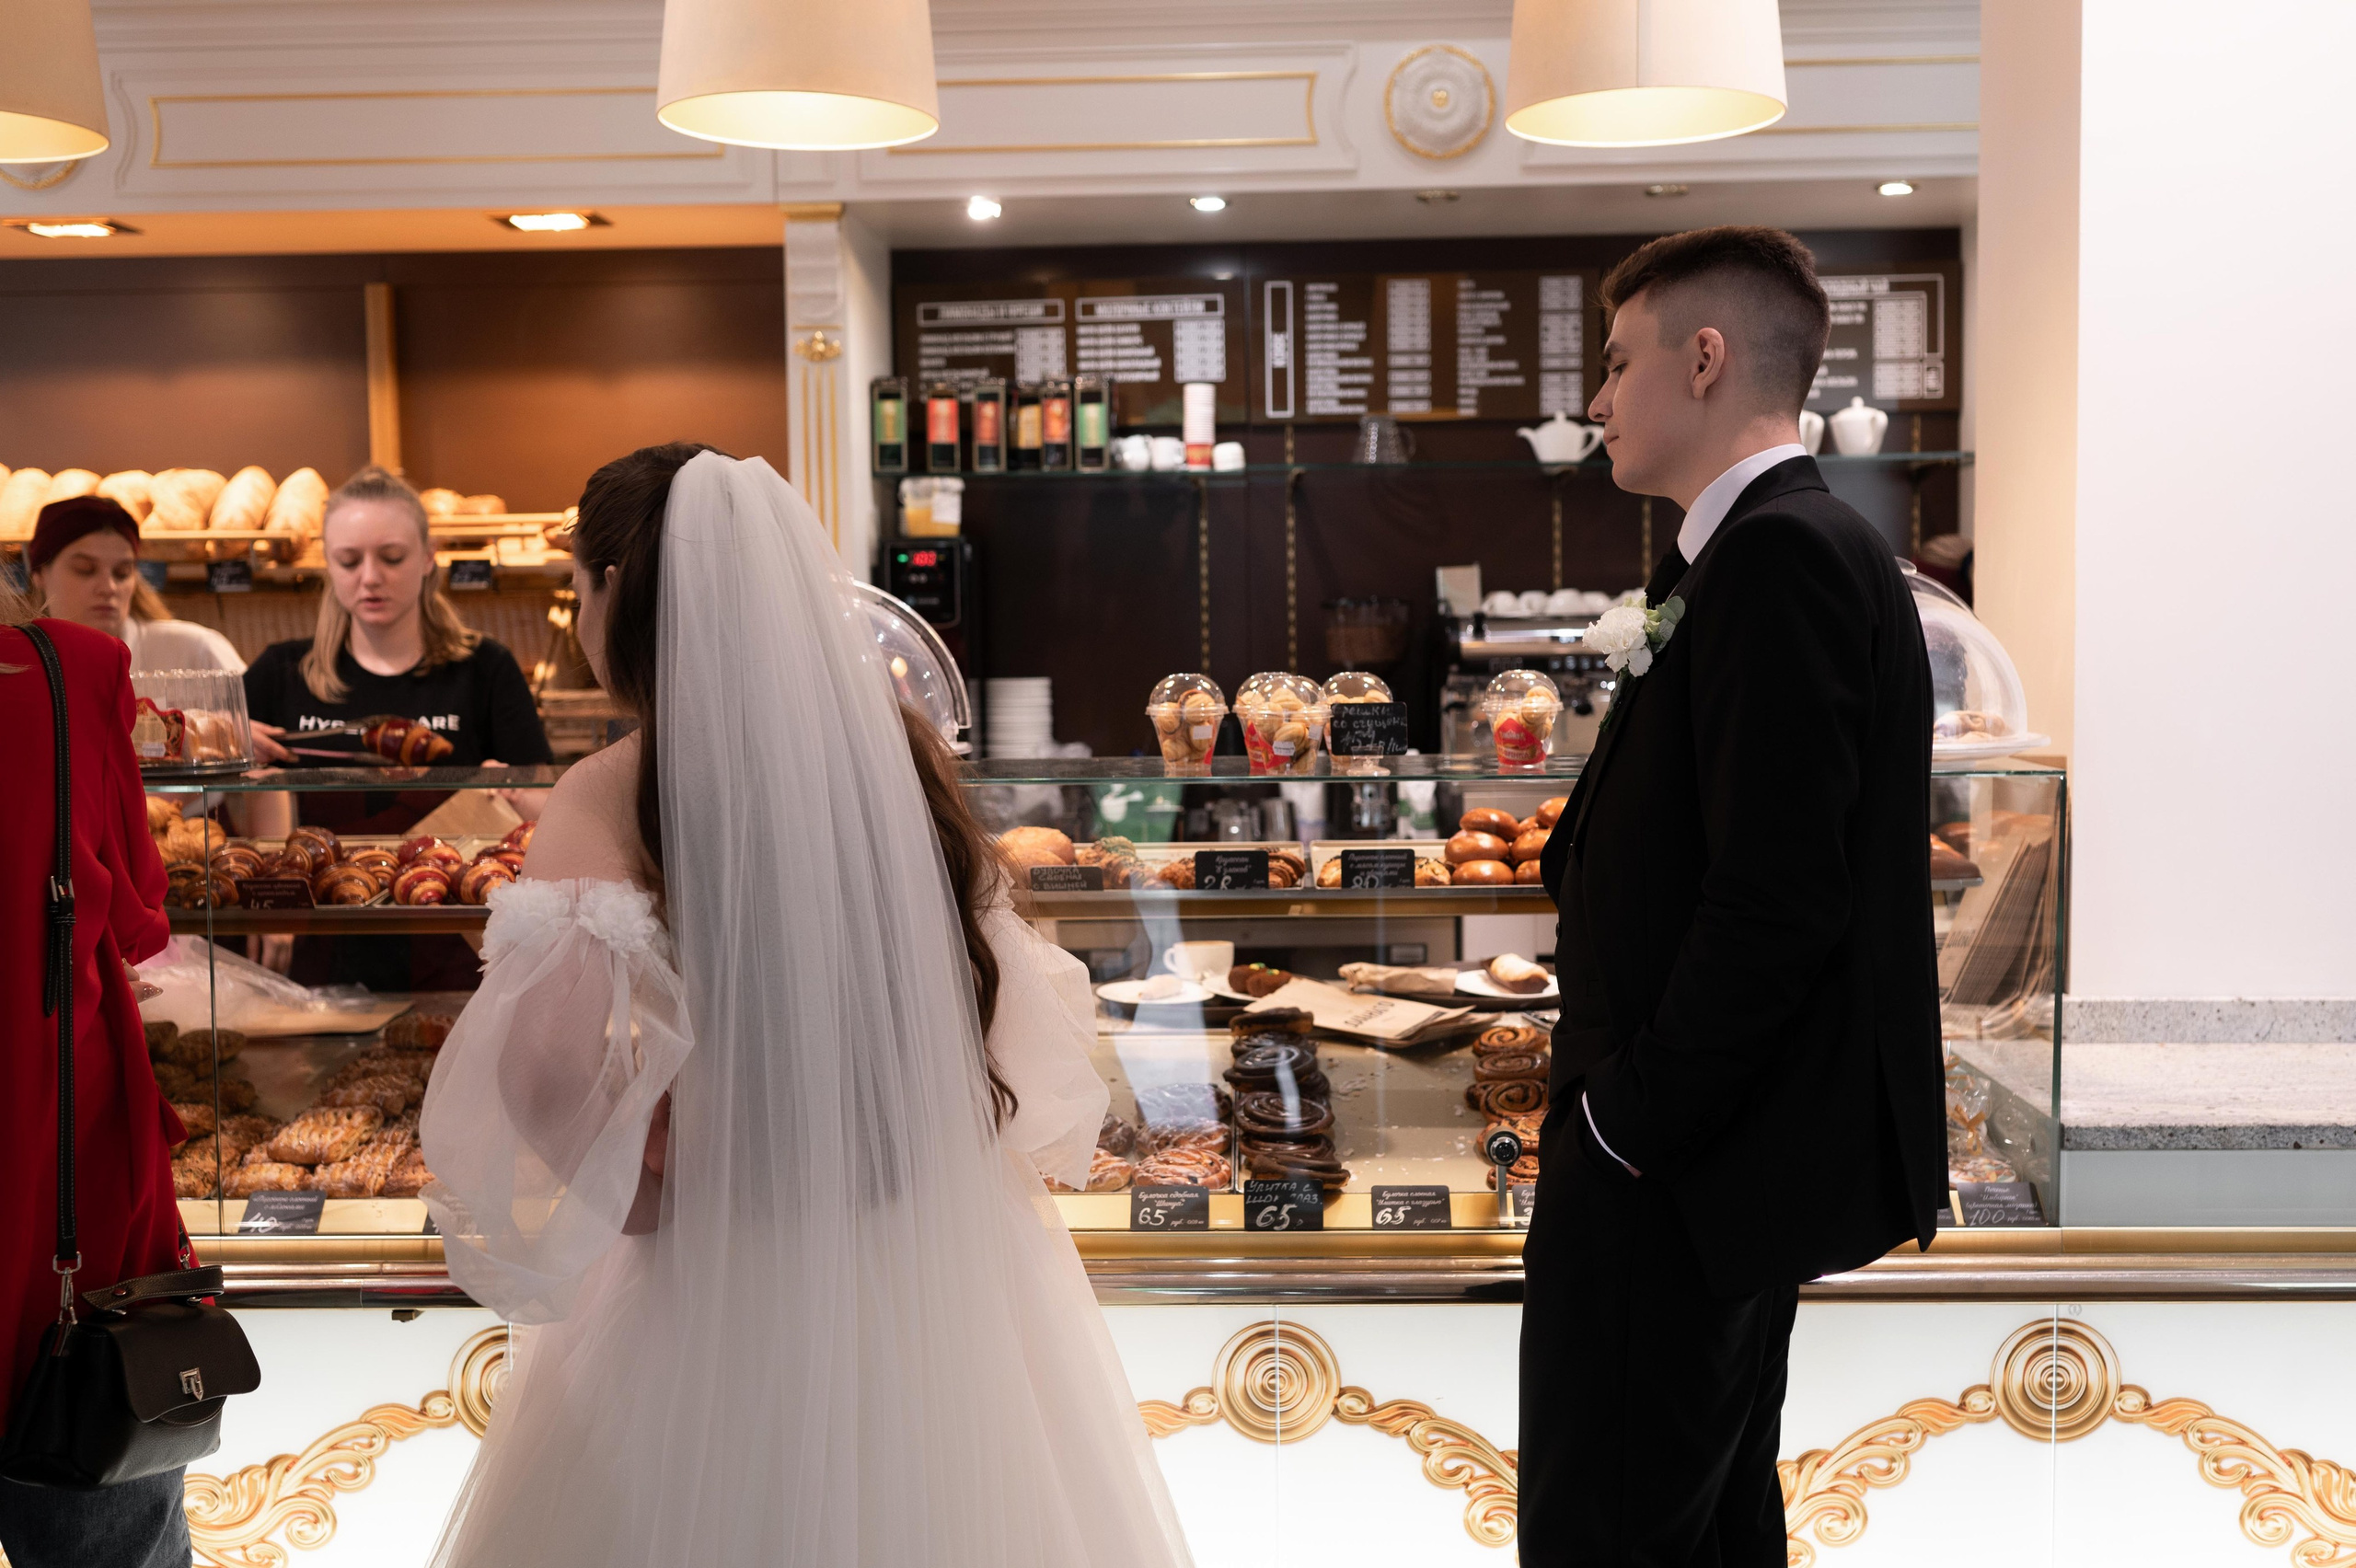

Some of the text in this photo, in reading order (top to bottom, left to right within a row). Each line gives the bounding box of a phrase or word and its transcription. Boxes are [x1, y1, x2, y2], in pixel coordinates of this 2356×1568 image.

[1138, 1191, 1168, 1202] Булочка
[1381, 1191, 1408, 1199] Булочка
[1138, 1207, 1168, 1226] 65
[1256, 1204, 1298, 1230] 65
[1376, 1205, 1412, 1225] 65
[1969, 1209, 2004, 1226] 100
